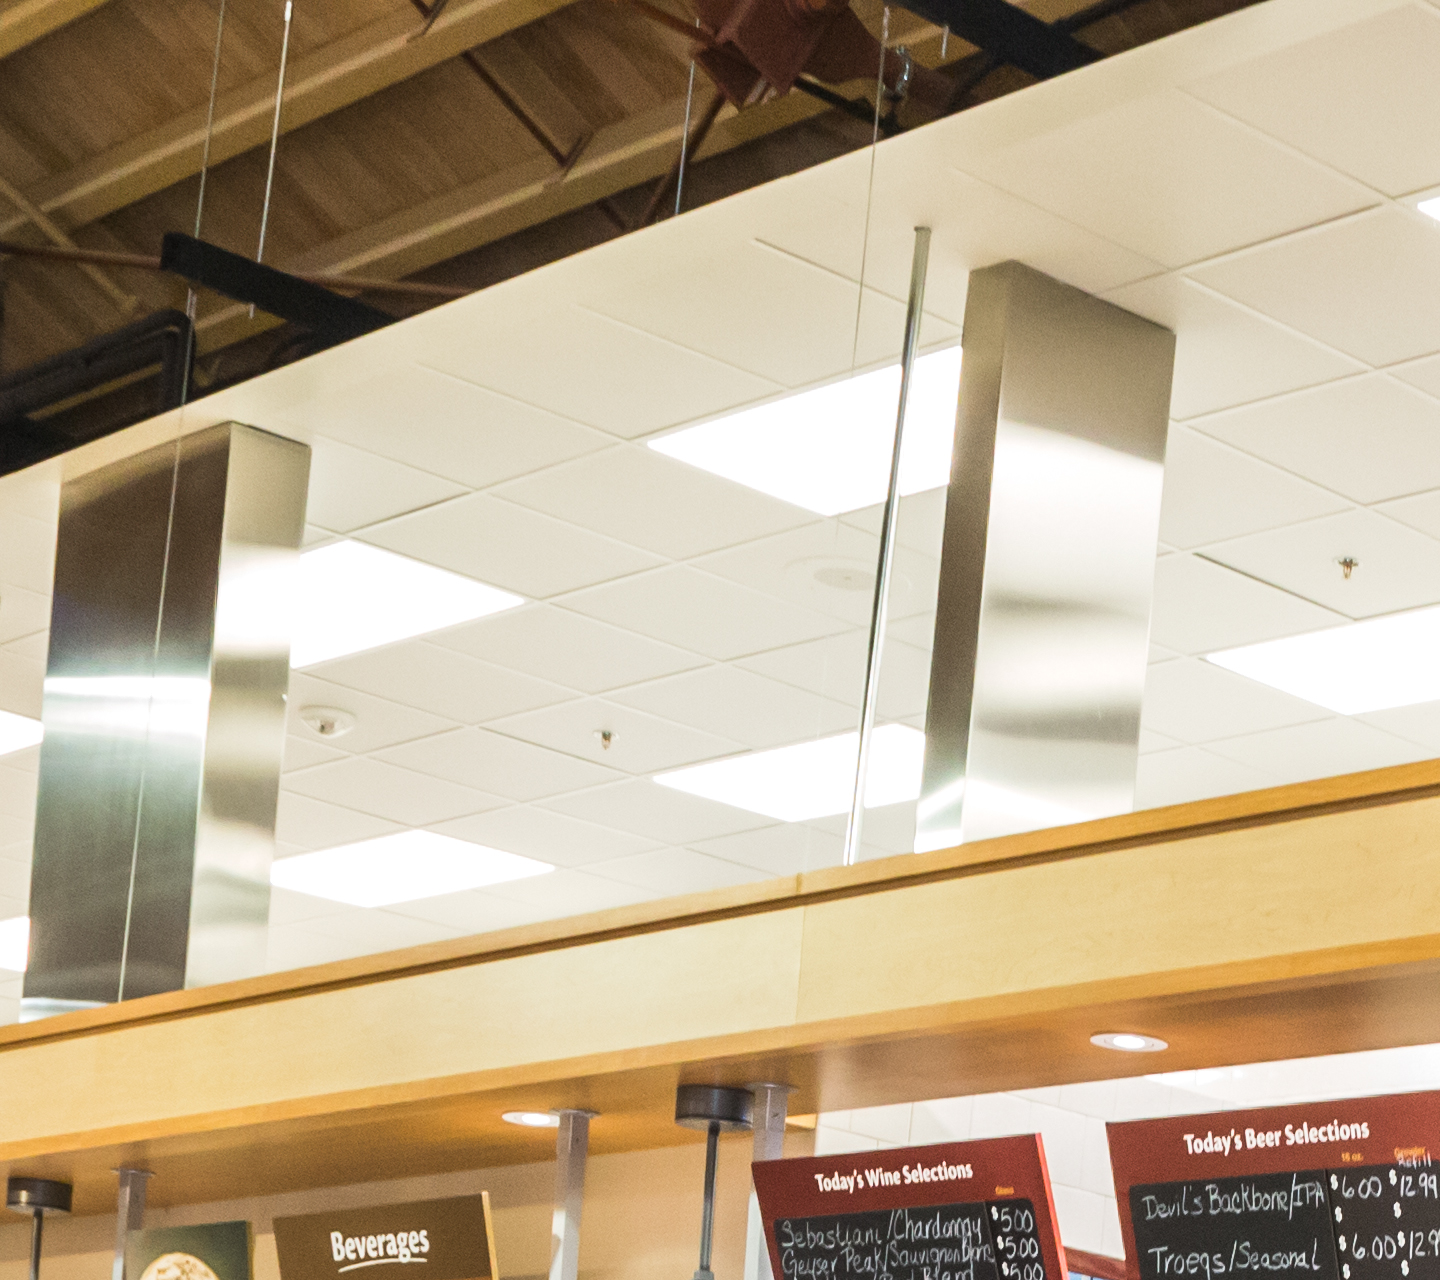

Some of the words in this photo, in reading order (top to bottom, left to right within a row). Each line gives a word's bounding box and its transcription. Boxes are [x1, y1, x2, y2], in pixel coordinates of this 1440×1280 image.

[1183, 1130, 1243, 1157] Today's
[1244, 1127, 1282, 1149] Beer
[1285, 1119, 1370, 1146] Selections
[815, 1169, 864, 1194] Today's
[864, 1167, 901, 1188] Wine
[902, 1161, 973, 1184] Selections
[1142, 1187, 1204, 1220] Devil's
[331, 1229, 430, 1264] Beverages
